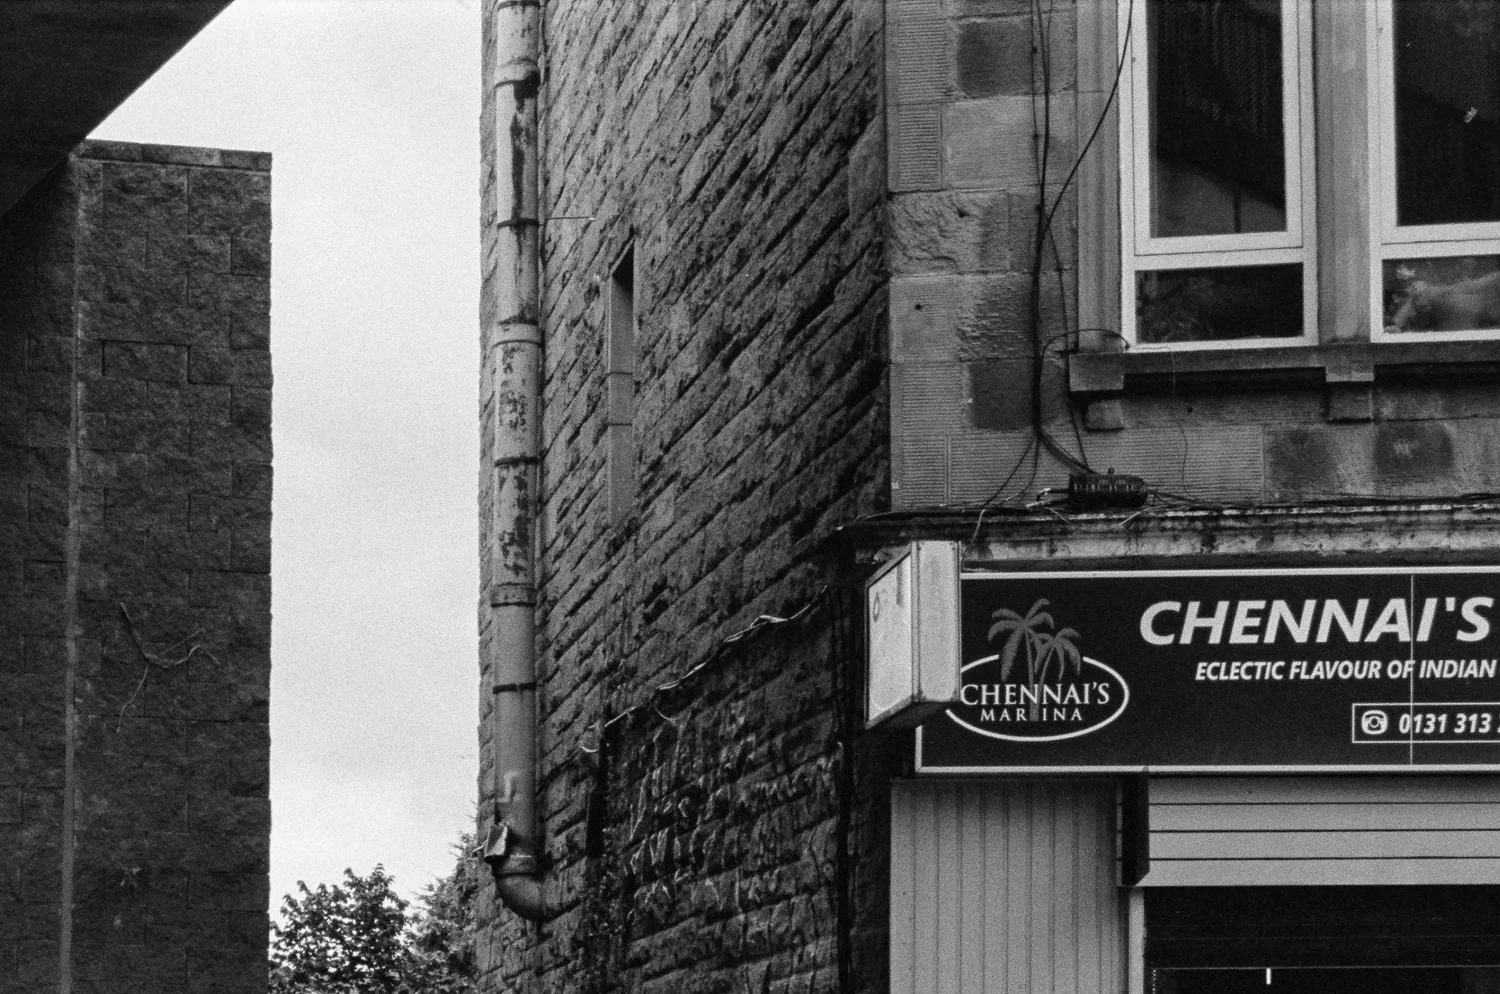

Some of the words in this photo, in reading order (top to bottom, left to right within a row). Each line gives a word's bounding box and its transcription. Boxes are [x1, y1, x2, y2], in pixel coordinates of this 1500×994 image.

[1139, 597, 1494, 645] CHENNAI'S
[1195, 661, 1285, 681] ECLECTIC
[1289, 660, 1382, 680] FLAVOUR
[1387, 659, 1416, 679] OF
[1418, 659, 1498, 679] INDIAN
[961, 682, 1110, 706] CHENNAI'S
[980, 707, 1083, 722] MARINA
[1399, 713, 1448, 734] 0131
[1453, 713, 1492, 734] 313
